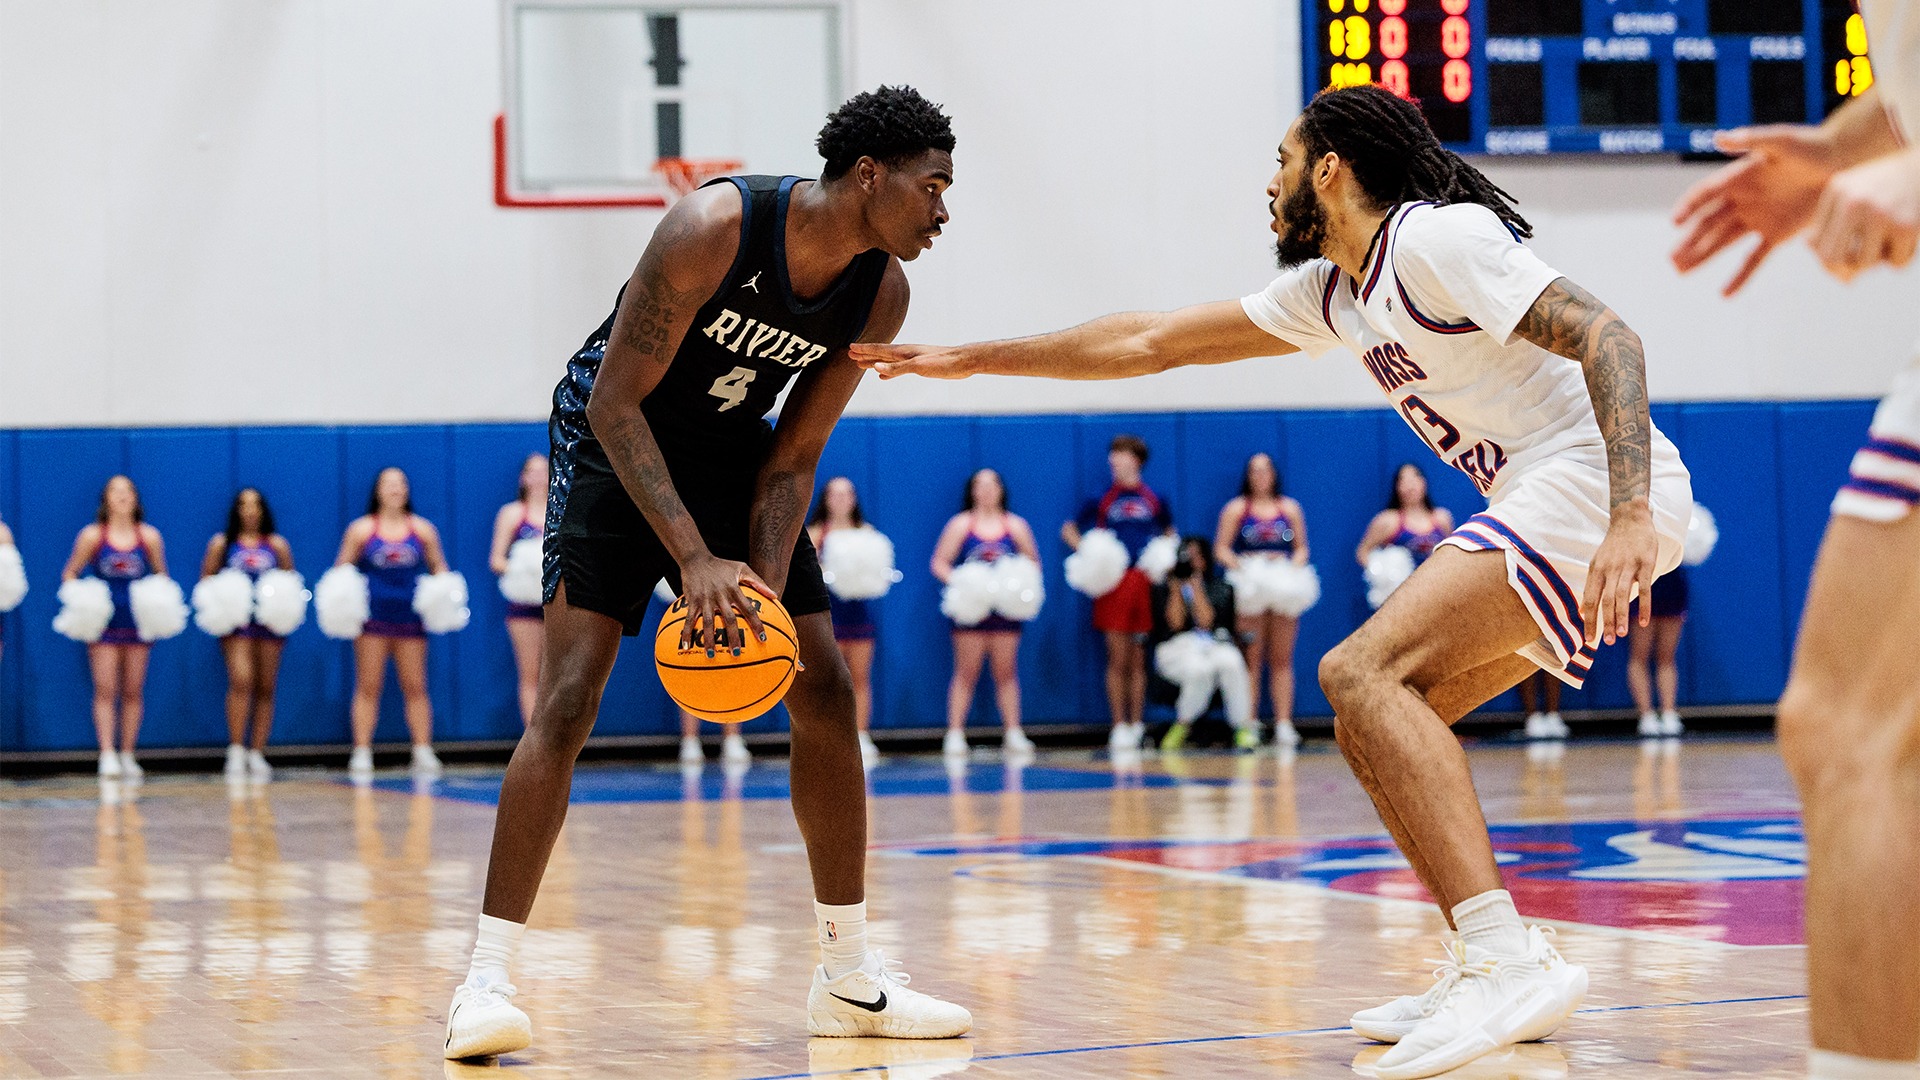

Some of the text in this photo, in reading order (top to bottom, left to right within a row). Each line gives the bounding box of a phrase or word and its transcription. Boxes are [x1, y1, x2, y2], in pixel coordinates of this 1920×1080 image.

[1613, 12, 1677, 34] BONUS
[1329, 15, 1371, 60] 13
[1485, 38, 1542, 61] FOULS
[1583, 37, 1650, 60] PLAYER
[1750, 36, 1806, 59] FOULS
[1485, 130, 1548, 154] SCORE
[1599, 129, 1664, 153] MATCH
[702, 308, 827, 368] RIVIER
[1362, 341, 1428, 395] MASS
[708, 366, 757, 412] 4
[1400, 394, 1461, 459] 13
